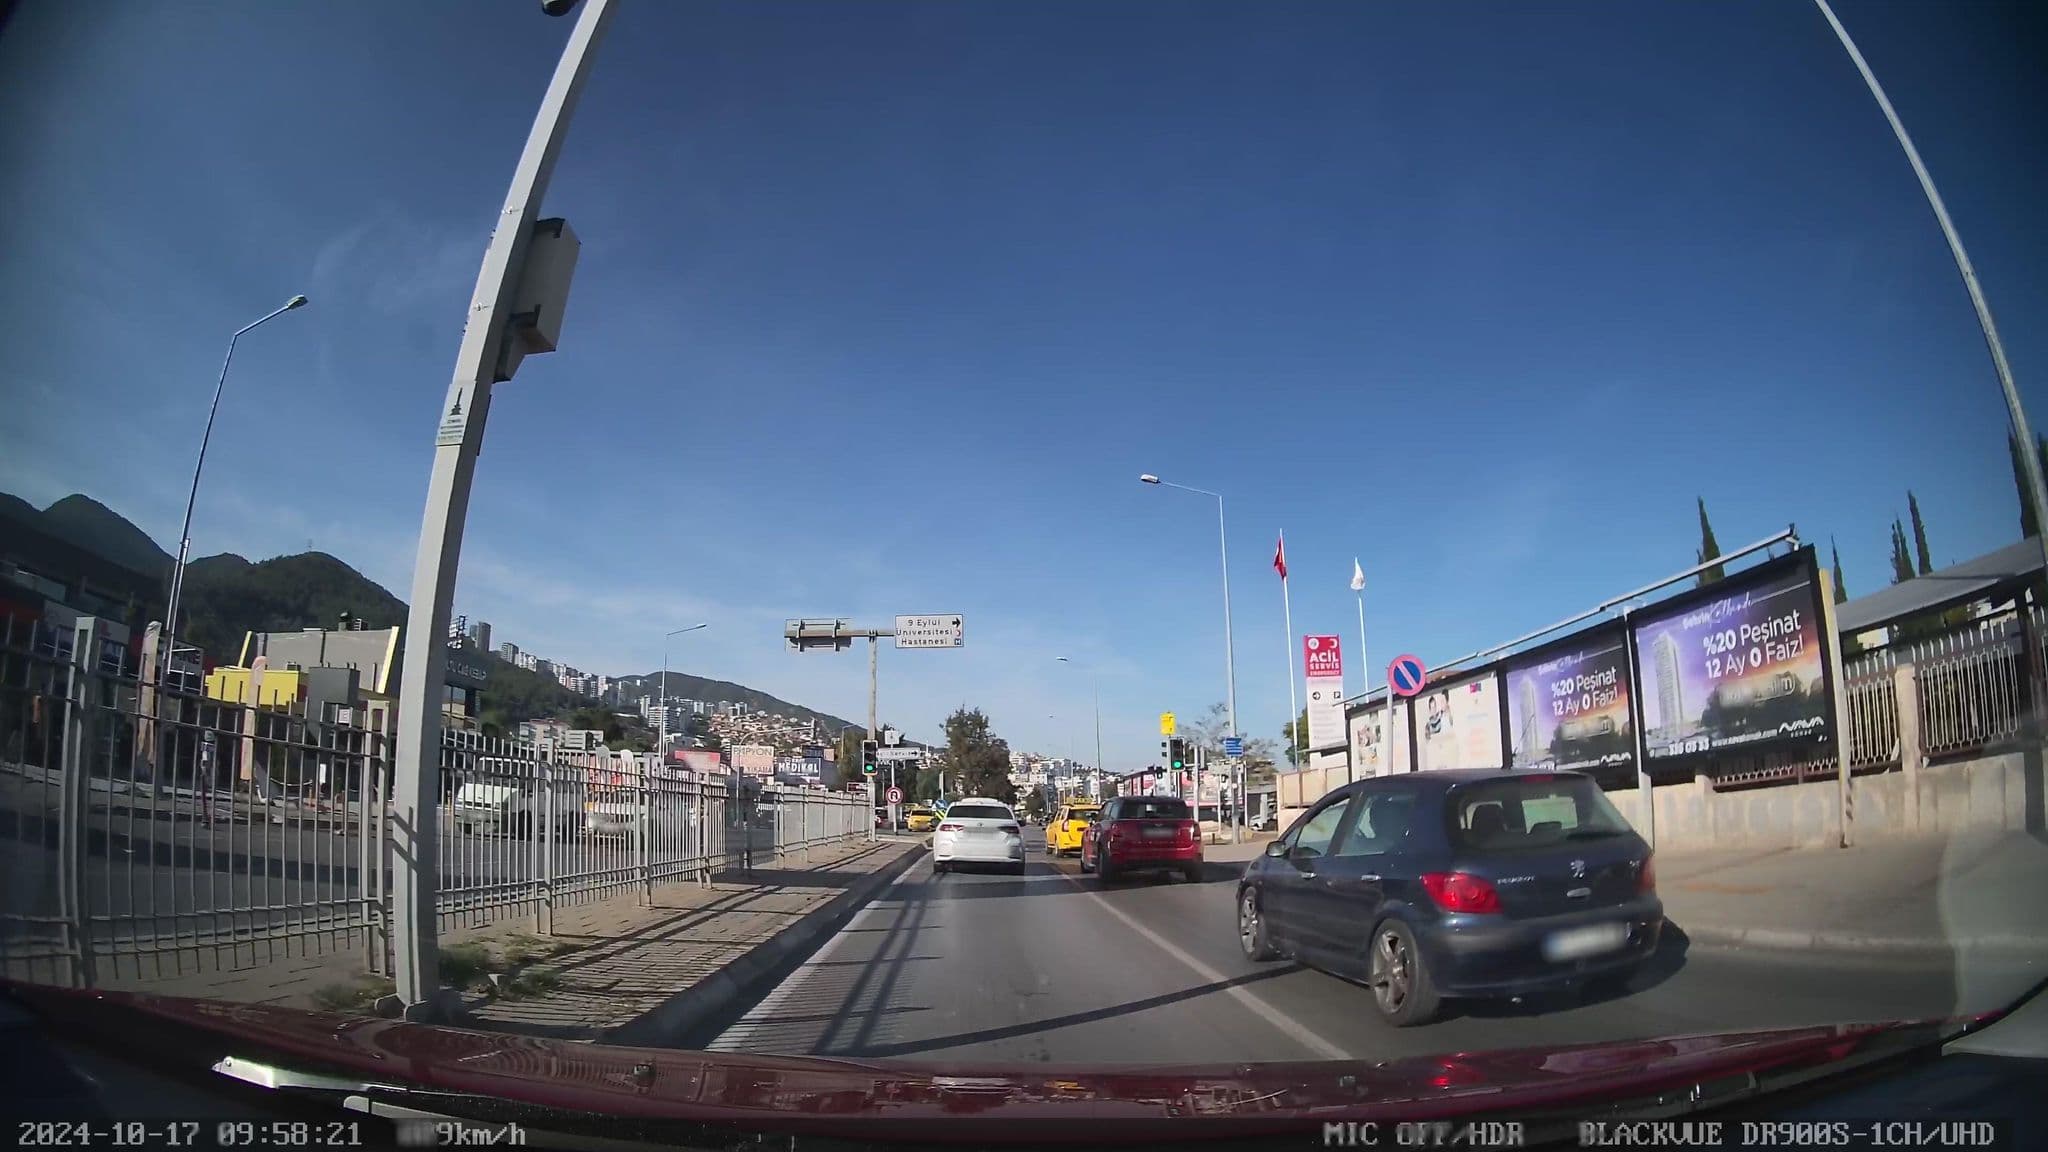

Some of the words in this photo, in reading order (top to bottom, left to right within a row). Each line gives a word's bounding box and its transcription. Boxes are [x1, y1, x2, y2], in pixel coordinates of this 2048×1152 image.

[907, 619, 914, 627] 9
[1703, 629, 1736, 656] %20
[1741, 609, 1802, 646] Peşinat
[901, 637, 948, 646] Hastanesi
[1705, 658, 1722, 680] 12
[1725, 654, 1746, 676] Ay
[1750, 647, 1762, 668] 0
[1765, 635, 1804, 664] Faiz!
[1551, 678, 1574, 698] %20
[1576, 665, 1617, 692] Peşinat
[1552, 700, 1564, 716] 12
[1565, 697, 1580, 716] Ay
[1582, 694, 1591, 710] 0
[1592, 687, 1618, 708] Faiz!
